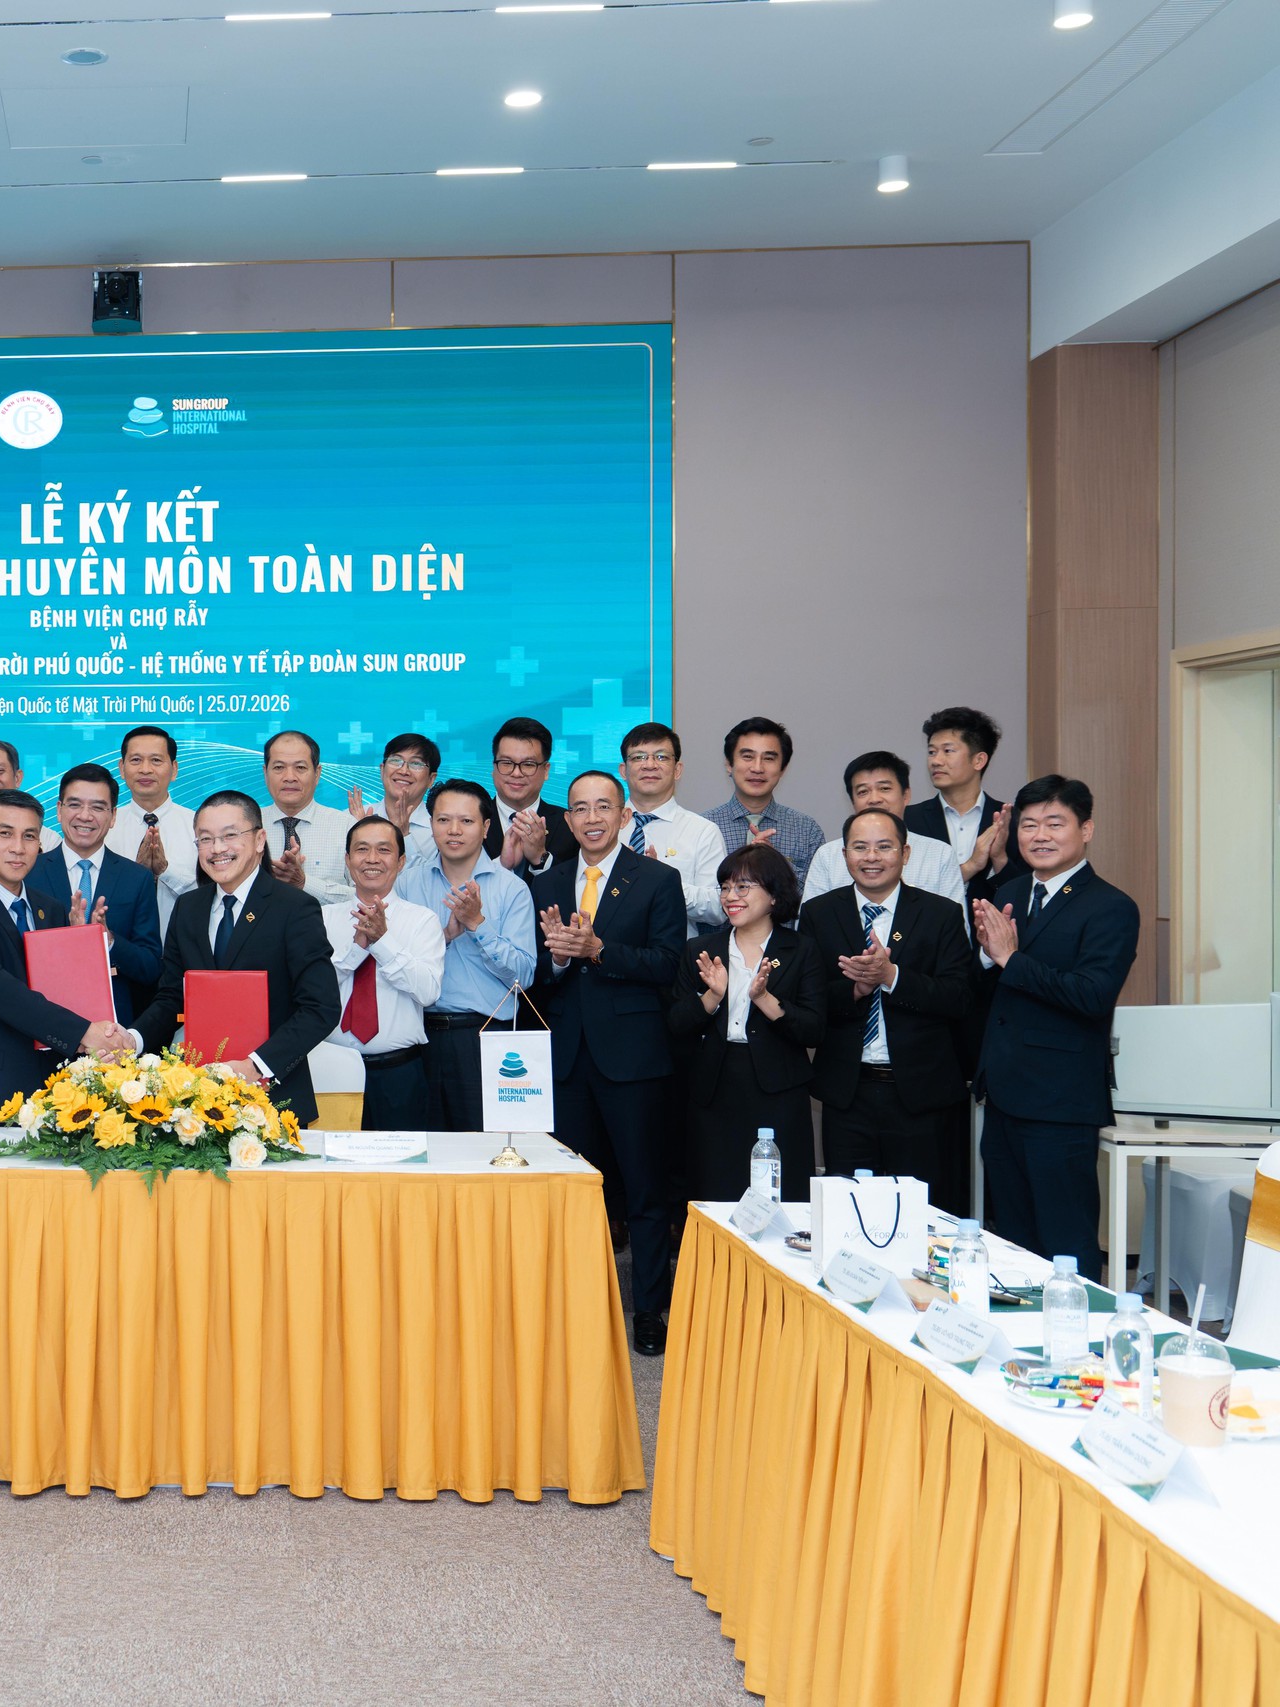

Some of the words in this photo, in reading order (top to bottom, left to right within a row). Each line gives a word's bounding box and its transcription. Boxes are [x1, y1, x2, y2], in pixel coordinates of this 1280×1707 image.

[172, 410, 248, 422] INTERNATIONAL
[172, 422, 220, 434] HOSPITAL
[20, 482, 64, 545] LỄ
[79, 489, 132, 544] KÝ
[146, 485, 220, 543] KẾT
[144, 545, 231, 595] MÔN
[248, 543, 353, 594] TOÀN
[372, 543, 464, 600] DIỆN
[30, 605, 77, 631] BỆNH
[83, 604, 123, 631] VIỆN
[129, 607, 168, 630] CHỢ
[174, 600, 209, 627] RẪY
[110, 632, 128, 650] VÀ
[34, 652, 70, 675] PHÚ
[75, 650, 124, 677] QUỐC
[141, 652, 164, 678] HỆ
[169, 650, 227, 674] THỐNG
[232, 655, 244, 674] Y
[248, 649, 270, 673] TẾ
[272, 650, 304, 677] TẬP
[309, 649, 357, 673] ĐOÀN
[363, 653, 398, 672] SUN
[403, 652, 466, 672] GROUP
[17, 695, 52, 716] Quốc
[55, 696, 70, 713] tế
[73, 696, 99, 716] Mặt
[102, 695, 125, 713] Trời
[131, 695, 157, 713] Phú
[160, 694, 195, 715] Quốc
[206, 695, 290, 713] 25.07.2026
[498, 1087, 543, 1096] INTERNATIONAL
[498, 1095, 527, 1103] HOSPITAL
